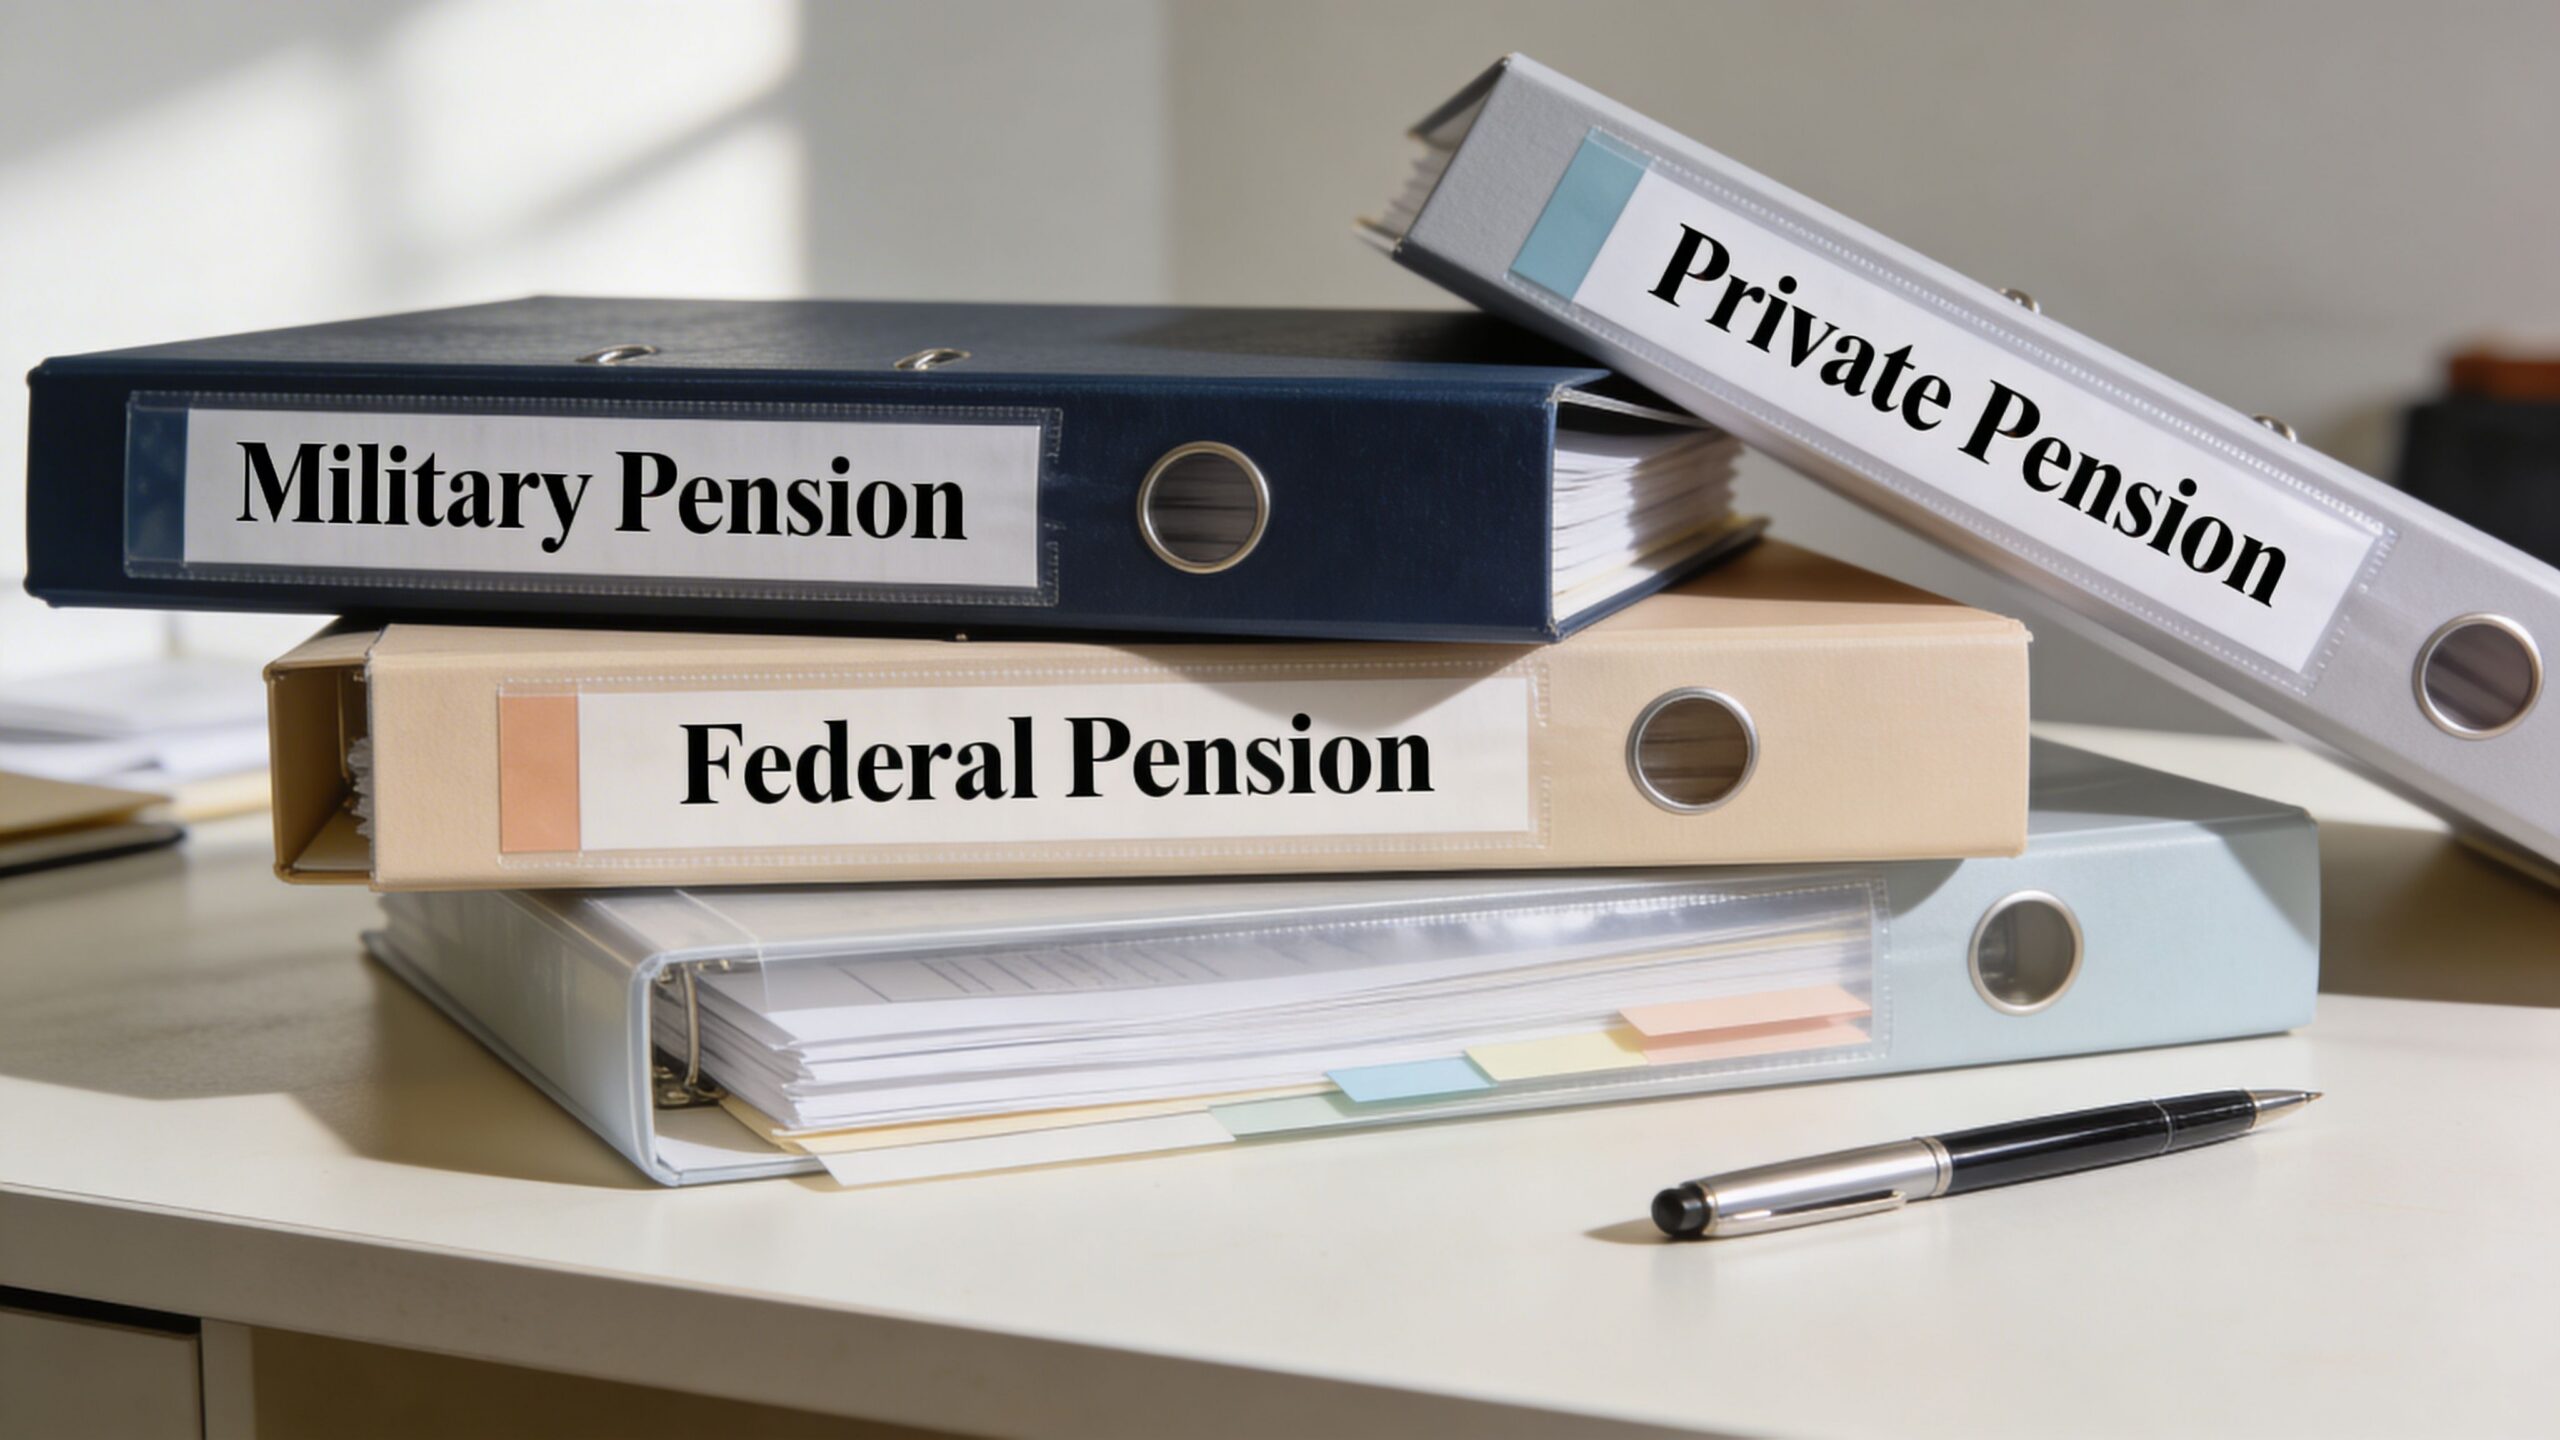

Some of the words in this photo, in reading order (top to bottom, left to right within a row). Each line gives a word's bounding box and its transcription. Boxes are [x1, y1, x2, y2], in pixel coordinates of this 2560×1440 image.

[1647, 223, 1953, 431] Private
[1958, 379, 2287, 609] Pension
[236, 441, 593, 554] Military
[615, 451, 969, 541] Pension
[680, 716, 1038, 805] Federal
[1065, 712, 1436, 798] Pension
